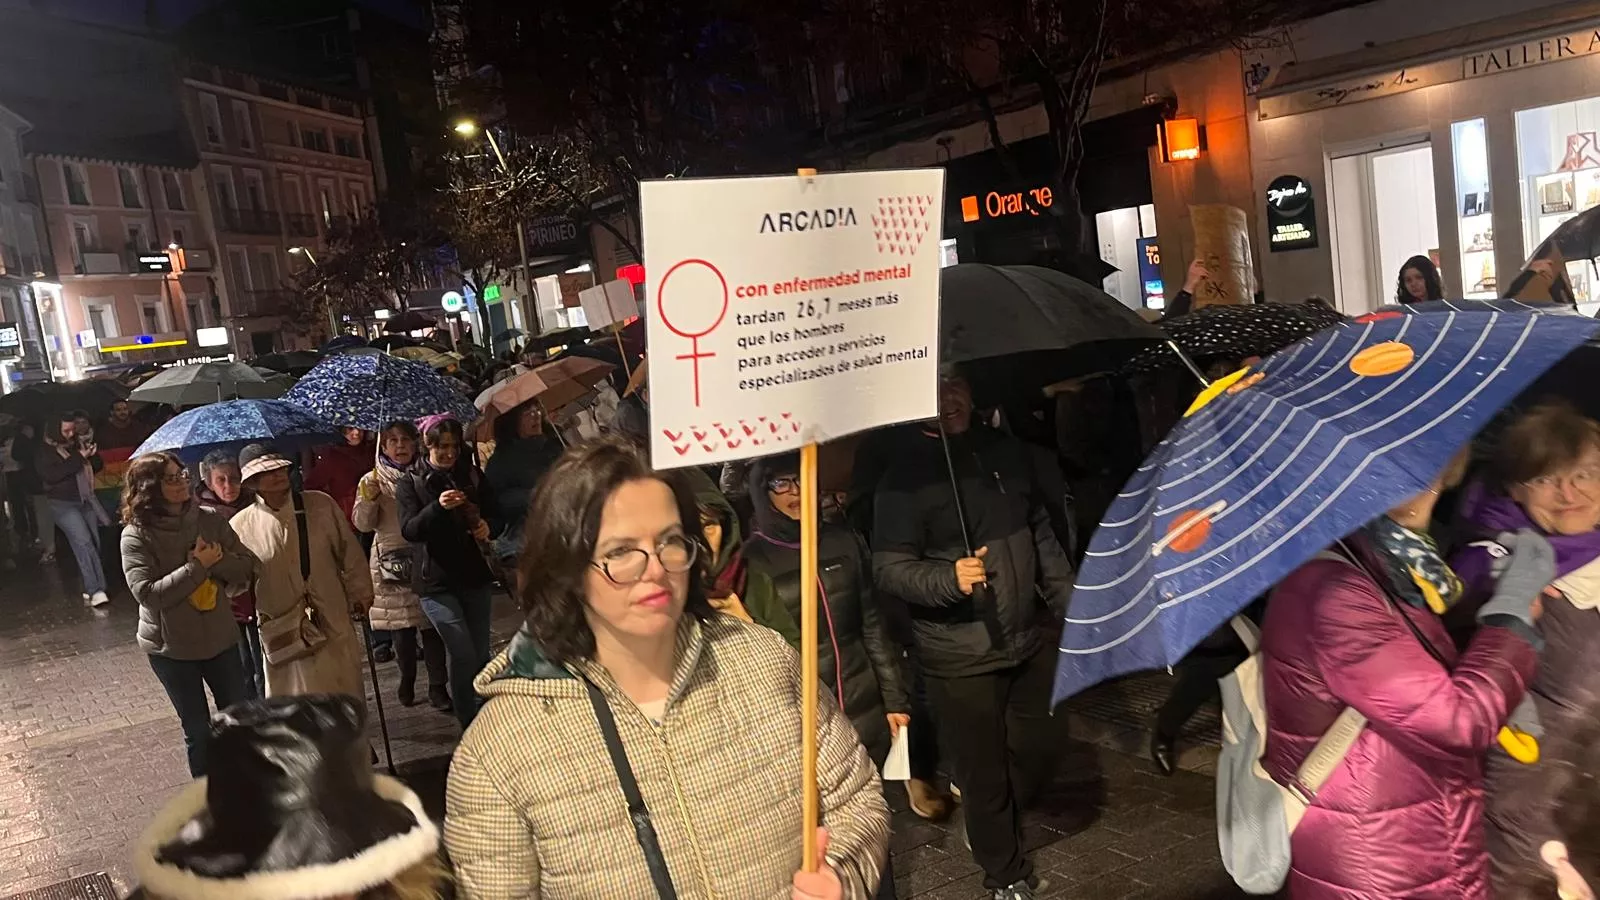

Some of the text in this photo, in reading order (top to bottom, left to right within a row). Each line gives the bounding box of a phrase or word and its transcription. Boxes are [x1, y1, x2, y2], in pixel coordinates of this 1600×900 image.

[1466, 36, 1576, 75] TALLER
[528, 222, 577, 247] PIRINEO
[735, 263, 911, 298] con enfermedad mental
[736, 291, 899, 326] tardan 26,7 meses más
[737, 322, 845, 349] que los hombres
[738, 333, 886, 372] para acceder a servicios
[739, 346, 928, 391] especializados de salud mental
